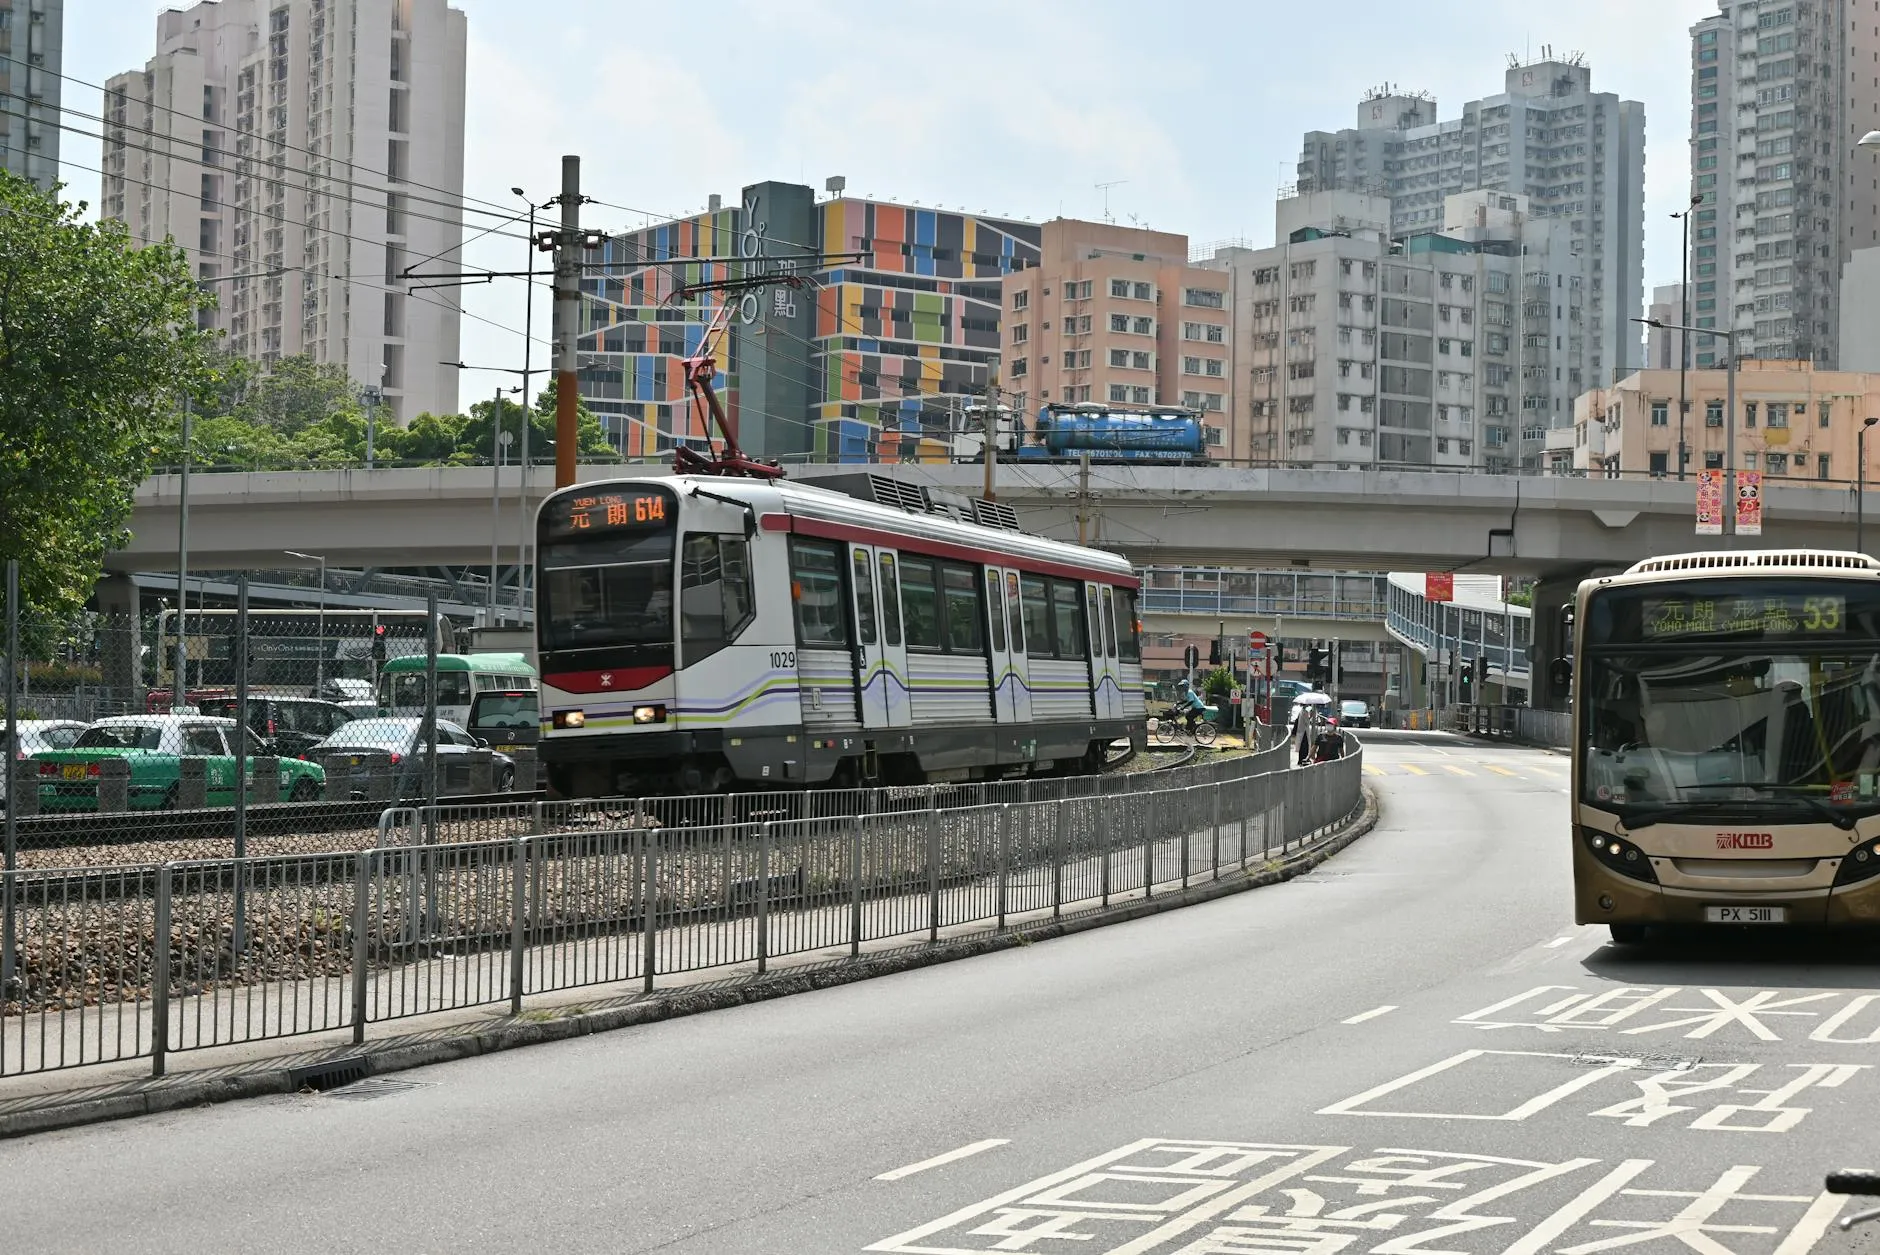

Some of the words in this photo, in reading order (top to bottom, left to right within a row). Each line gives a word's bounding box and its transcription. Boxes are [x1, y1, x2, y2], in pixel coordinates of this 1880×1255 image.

[573, 497, 596, 506] YUEN
[600, 495, 622, 505] LONG
[635, 496, 665, 521] 614
[1662, 600, 1714, 621] 元朗
[1802, 597, 1840, 630] 53
[1651, 619, 1682, 632] YOHO
[1686, 619, 1717, 632] MALL
[769, 651, 796, 669] 1029
[1732, 832, 1774, 850] KMB
[1720, 908, 1741, 921] PX
[1749, 908, 1771, 921] 5111
